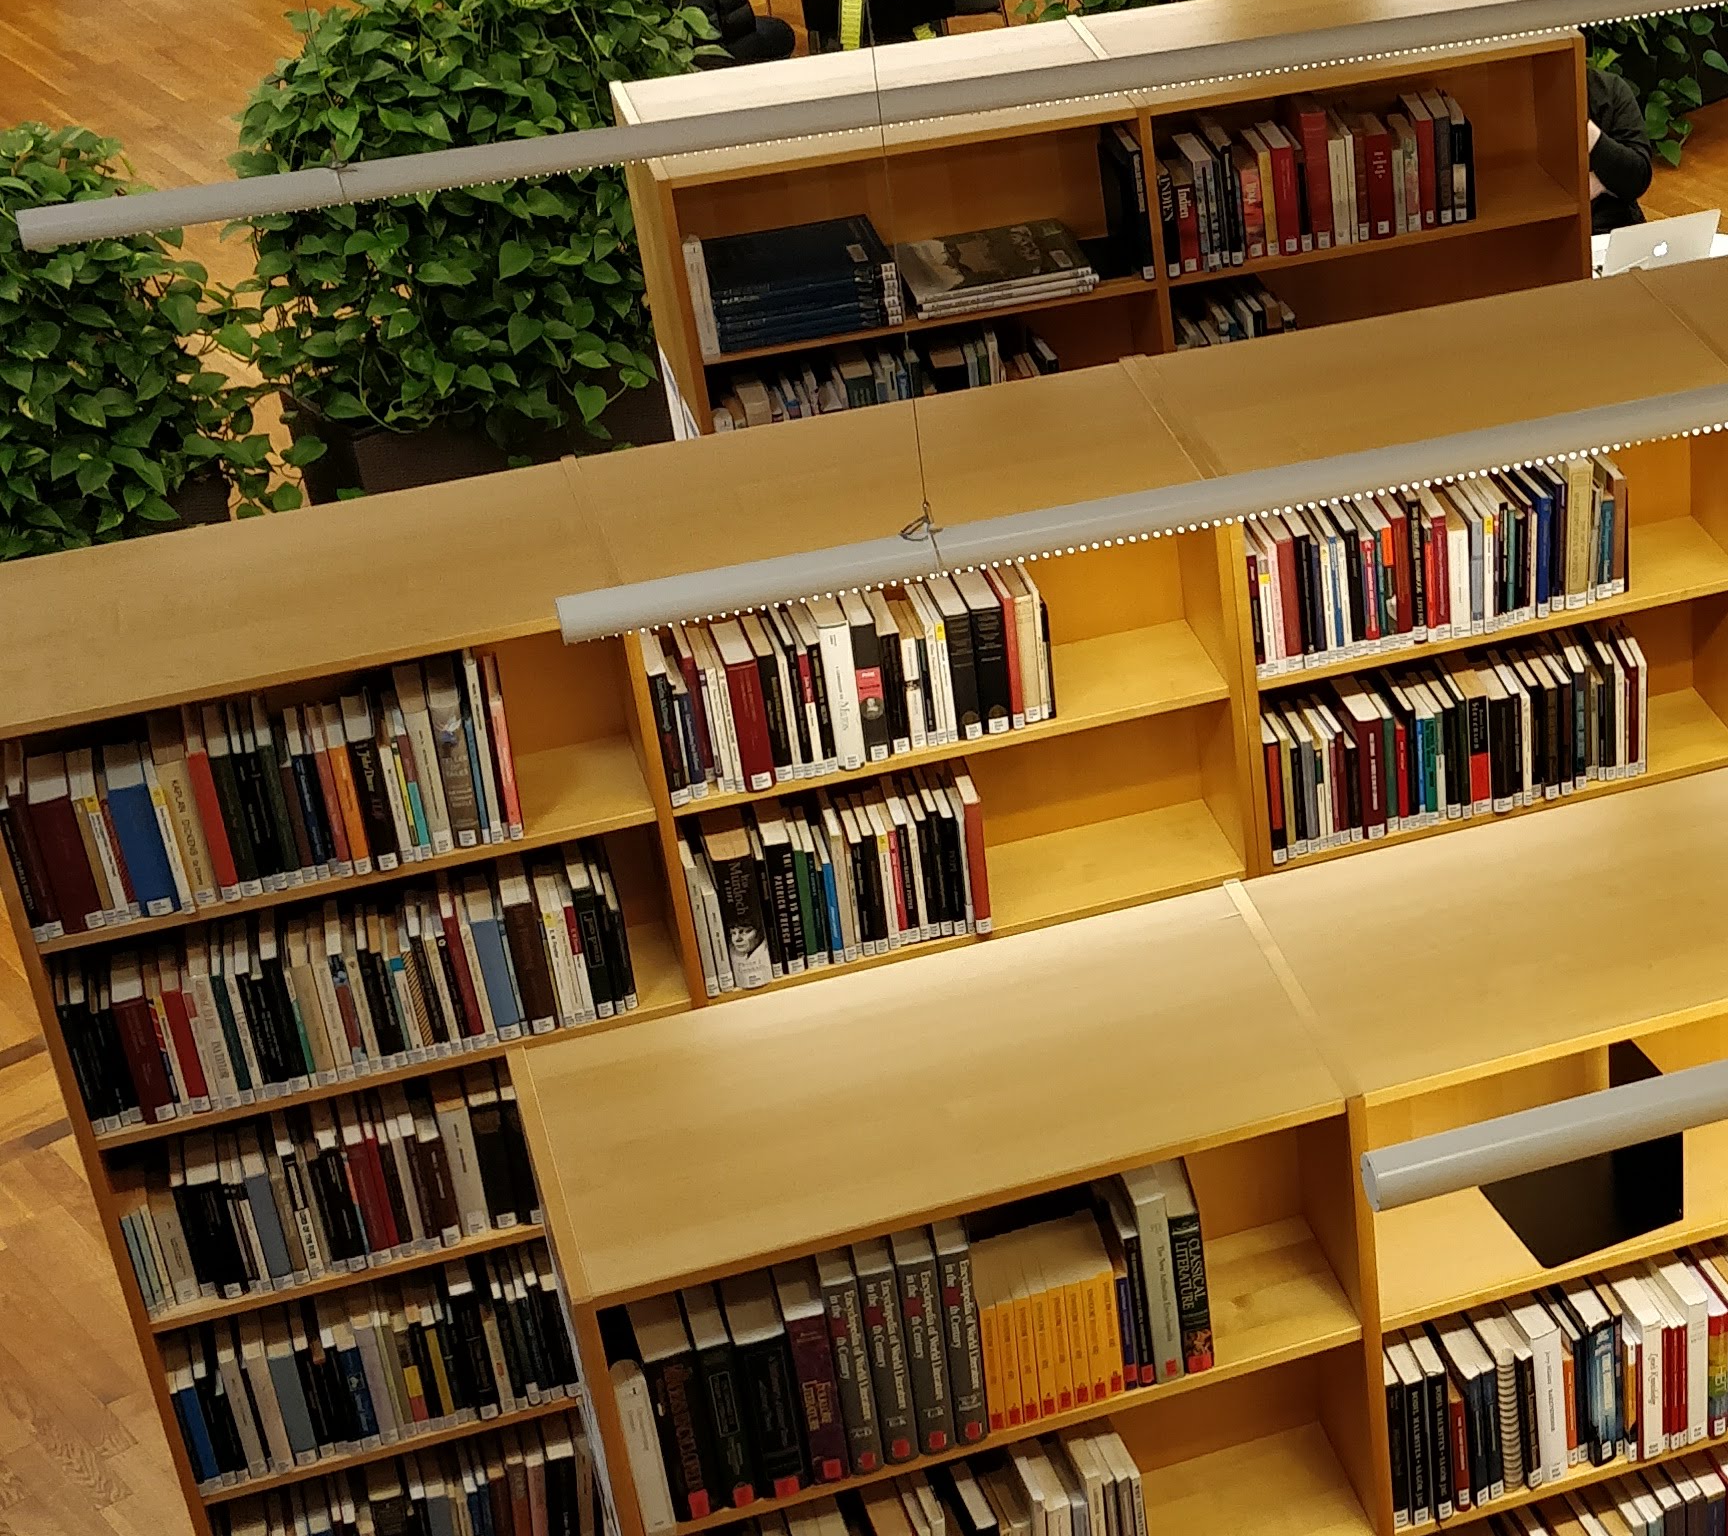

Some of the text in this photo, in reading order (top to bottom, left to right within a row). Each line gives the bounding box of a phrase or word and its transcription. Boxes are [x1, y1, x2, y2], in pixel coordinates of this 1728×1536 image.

[1160, 177, 1174, 222] INDIEN
[1177, 187, 1189, 218] Indien
[171, 778, 187, 813] KAPLAN
[727, 861, 749, 915] Murdoch
[772, 874, 792, 944] PATRICK FRENCH
[954, 1259, 976, 1315] Encyclopedia
[1173, 1241, 1196, 1310] LITERATURE
[1185, 1237, 1207, 1300] CLASSICAL
[878, 1279, 898, 1334] Encyclopedia
[917, 1269, 938, 1324] Encyclopedia
[842, 1289, 861, 1345] Encyclopedia
[947, 1315, 963, 1349] Century
[964, 1324, 978, 1349] World
[871, 1334, 887, 1368] Century
[889, 1344, 903, 1369] World
[909, 1325, 926, 1359] Century
[926, 1335, 941, 1360] World
[835, 1345, 851, 1380] Century
[853, 1354, 867, 1381] World
[930, 1360, 947, 1400] Literature
[966, 1350, 983, 1389] Literature
[857, 1381, 873, 1420] Literature
[892, 1369, 908, 1409] Literature
